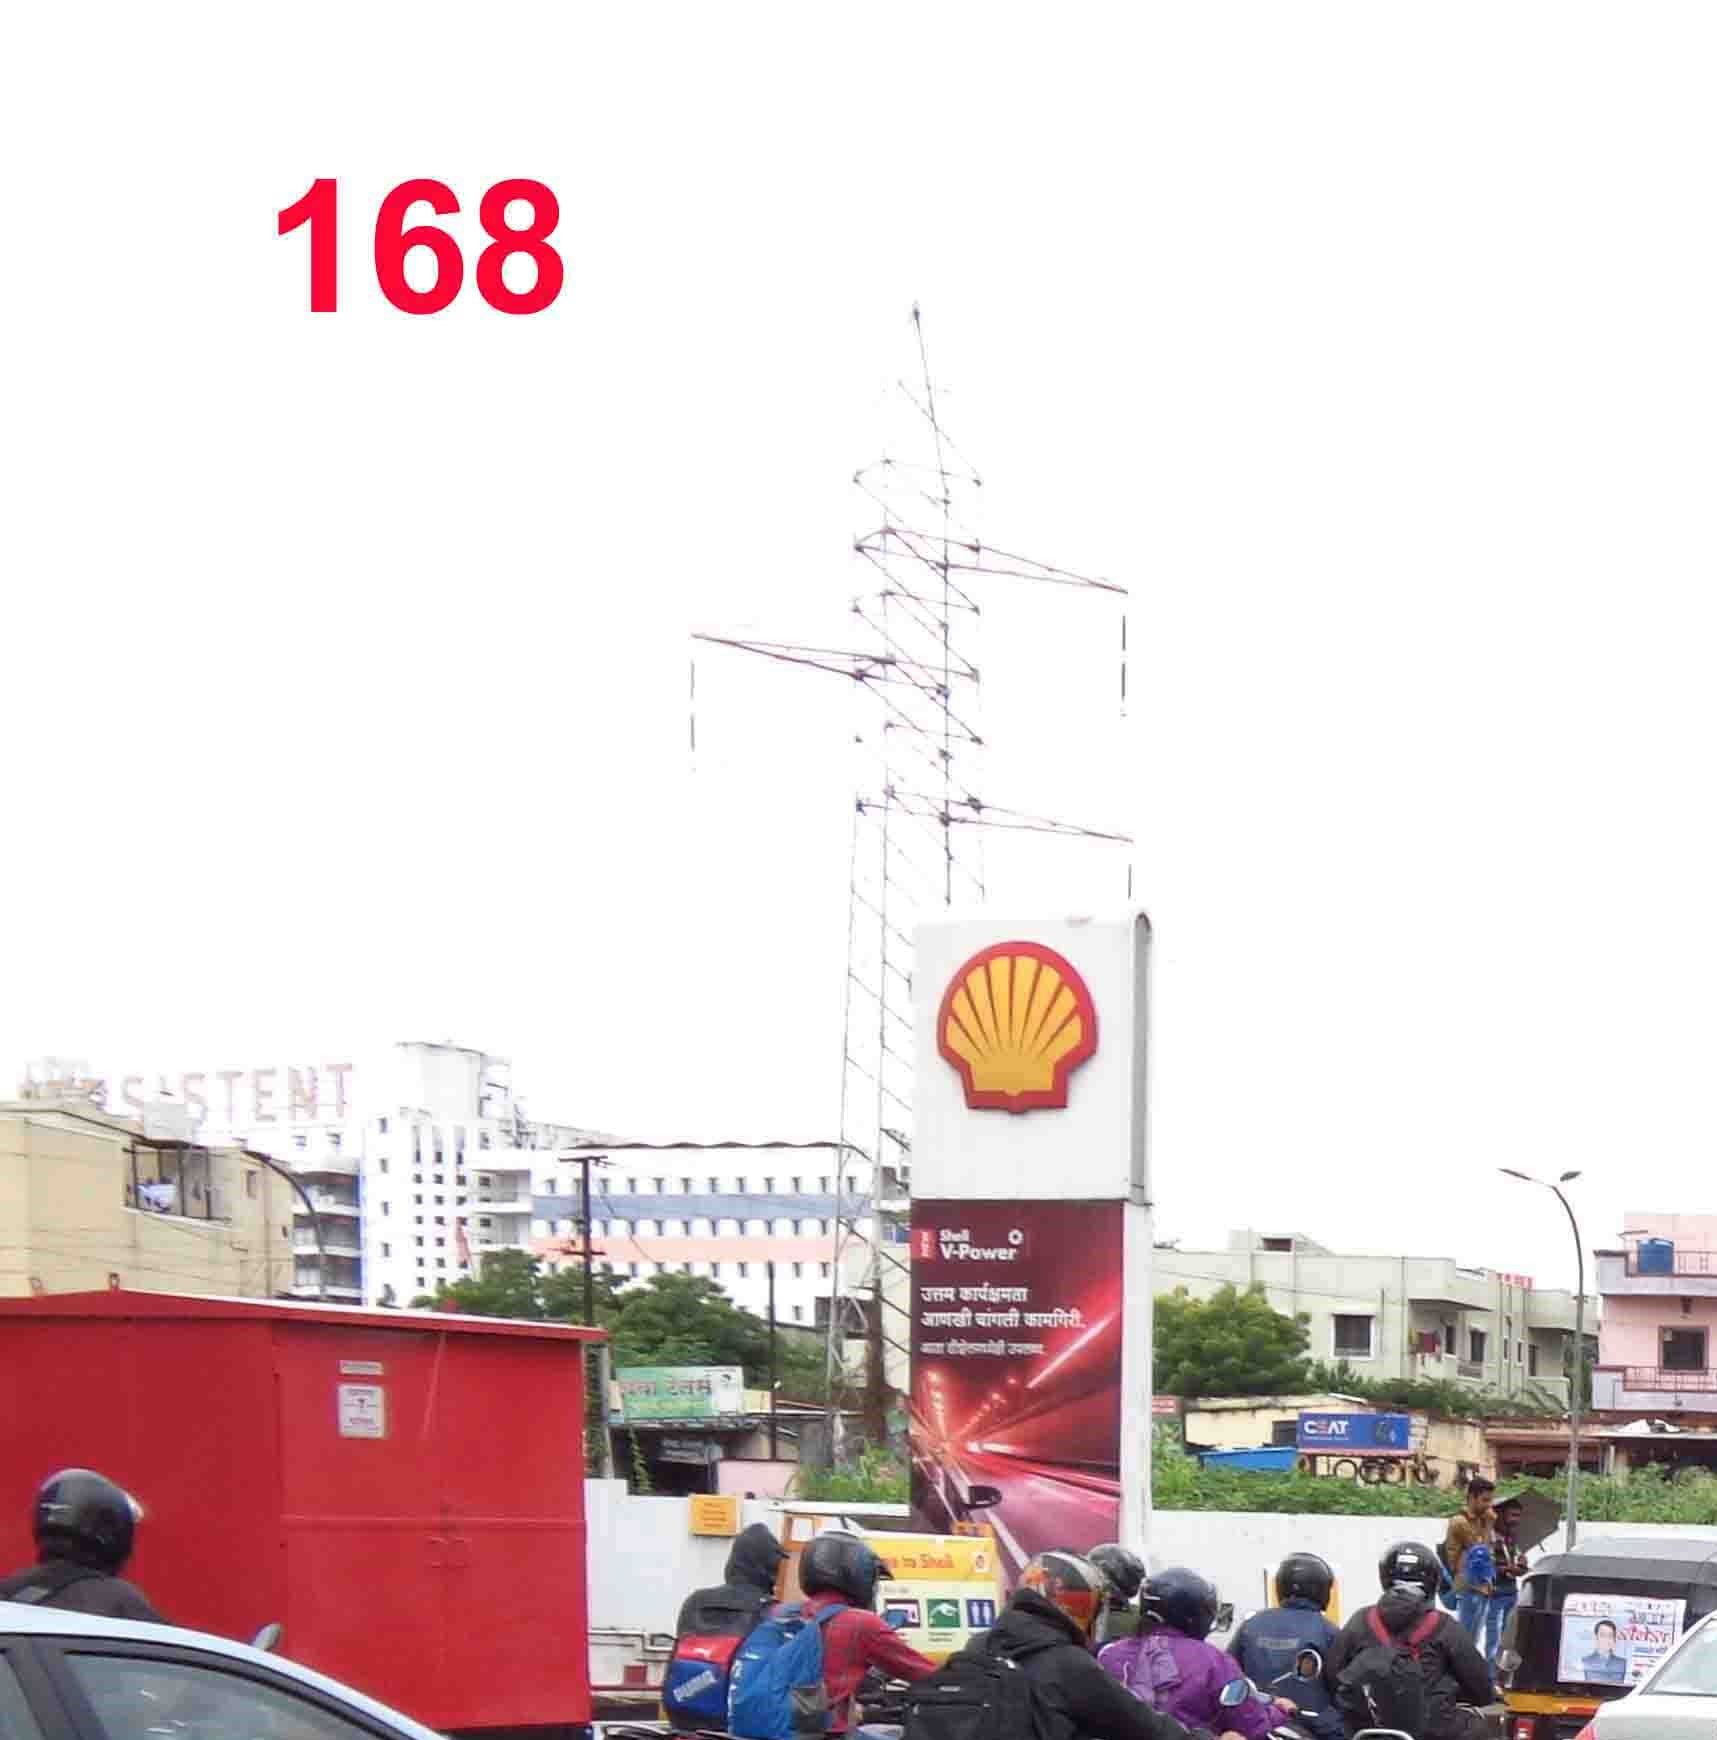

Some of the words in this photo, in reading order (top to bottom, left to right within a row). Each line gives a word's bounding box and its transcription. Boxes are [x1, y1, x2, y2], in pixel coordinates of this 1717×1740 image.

[940, 1229, 970, 1243] Shell
[940, 1243, 1017, 1260] V-Power
[1304, 1420, 1349, 1435] CEAT
